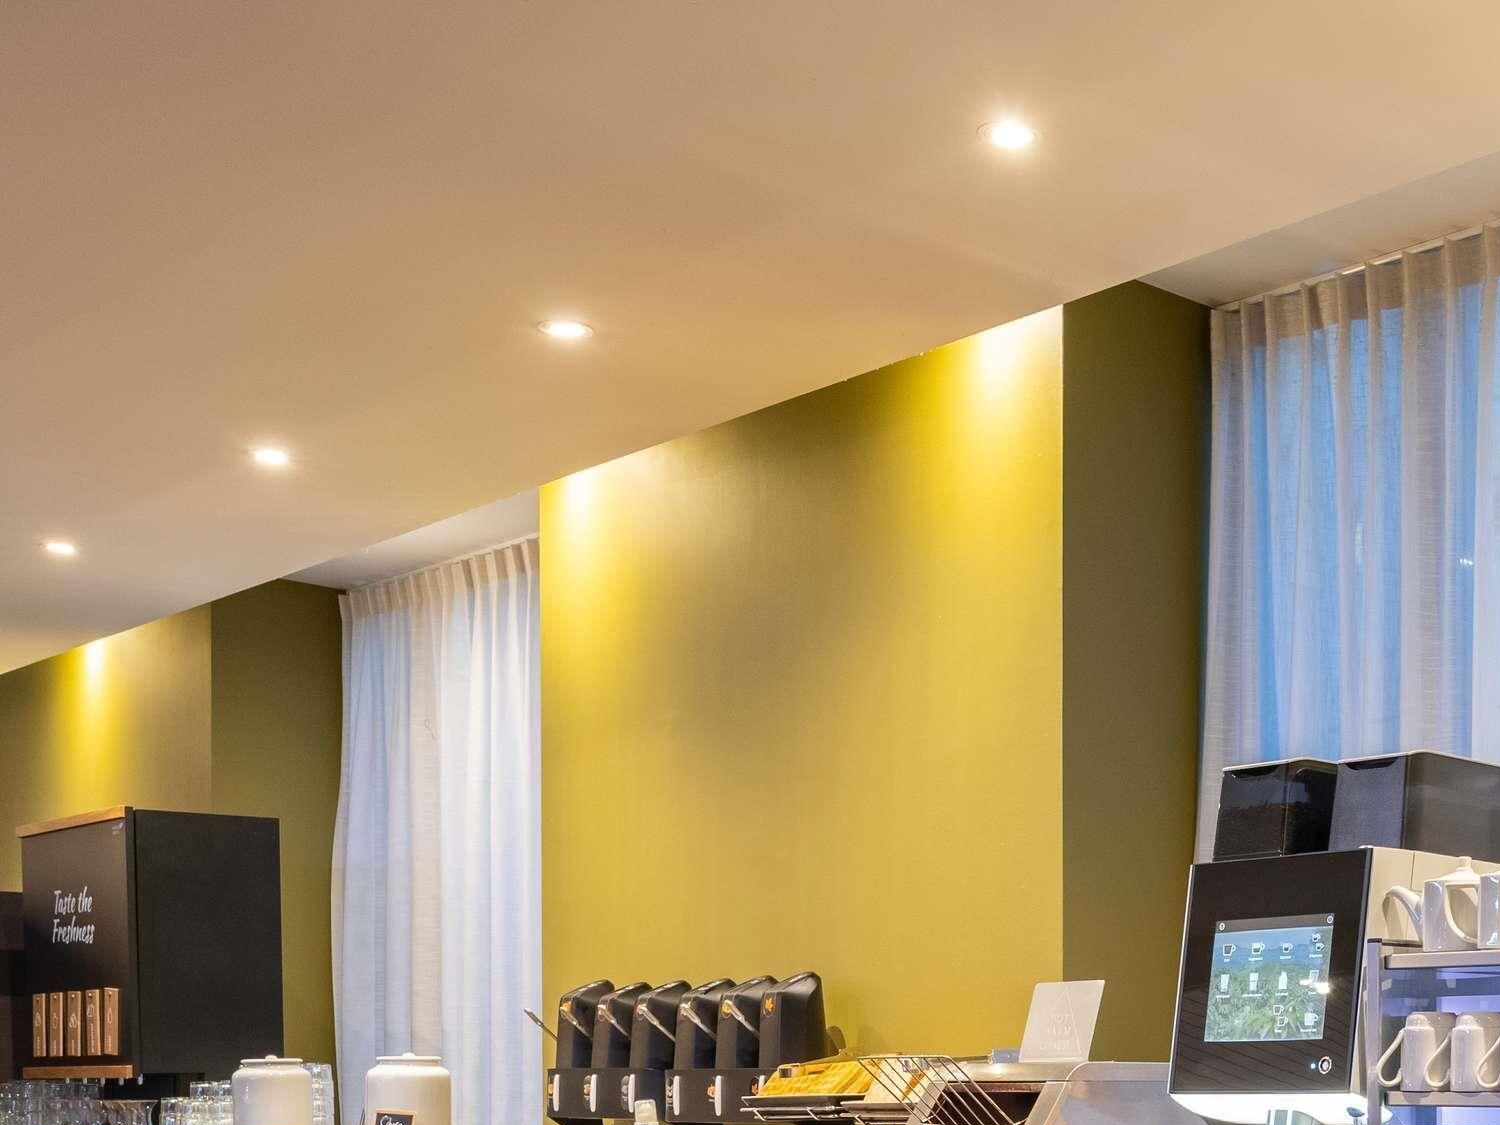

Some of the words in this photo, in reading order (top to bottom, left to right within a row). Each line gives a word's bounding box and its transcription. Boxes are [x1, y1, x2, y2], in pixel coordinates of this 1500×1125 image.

[54, 890, 76, 915] Taste
[78, 886, 93, 913] the
[52, 915, 95, 944] Freshness
